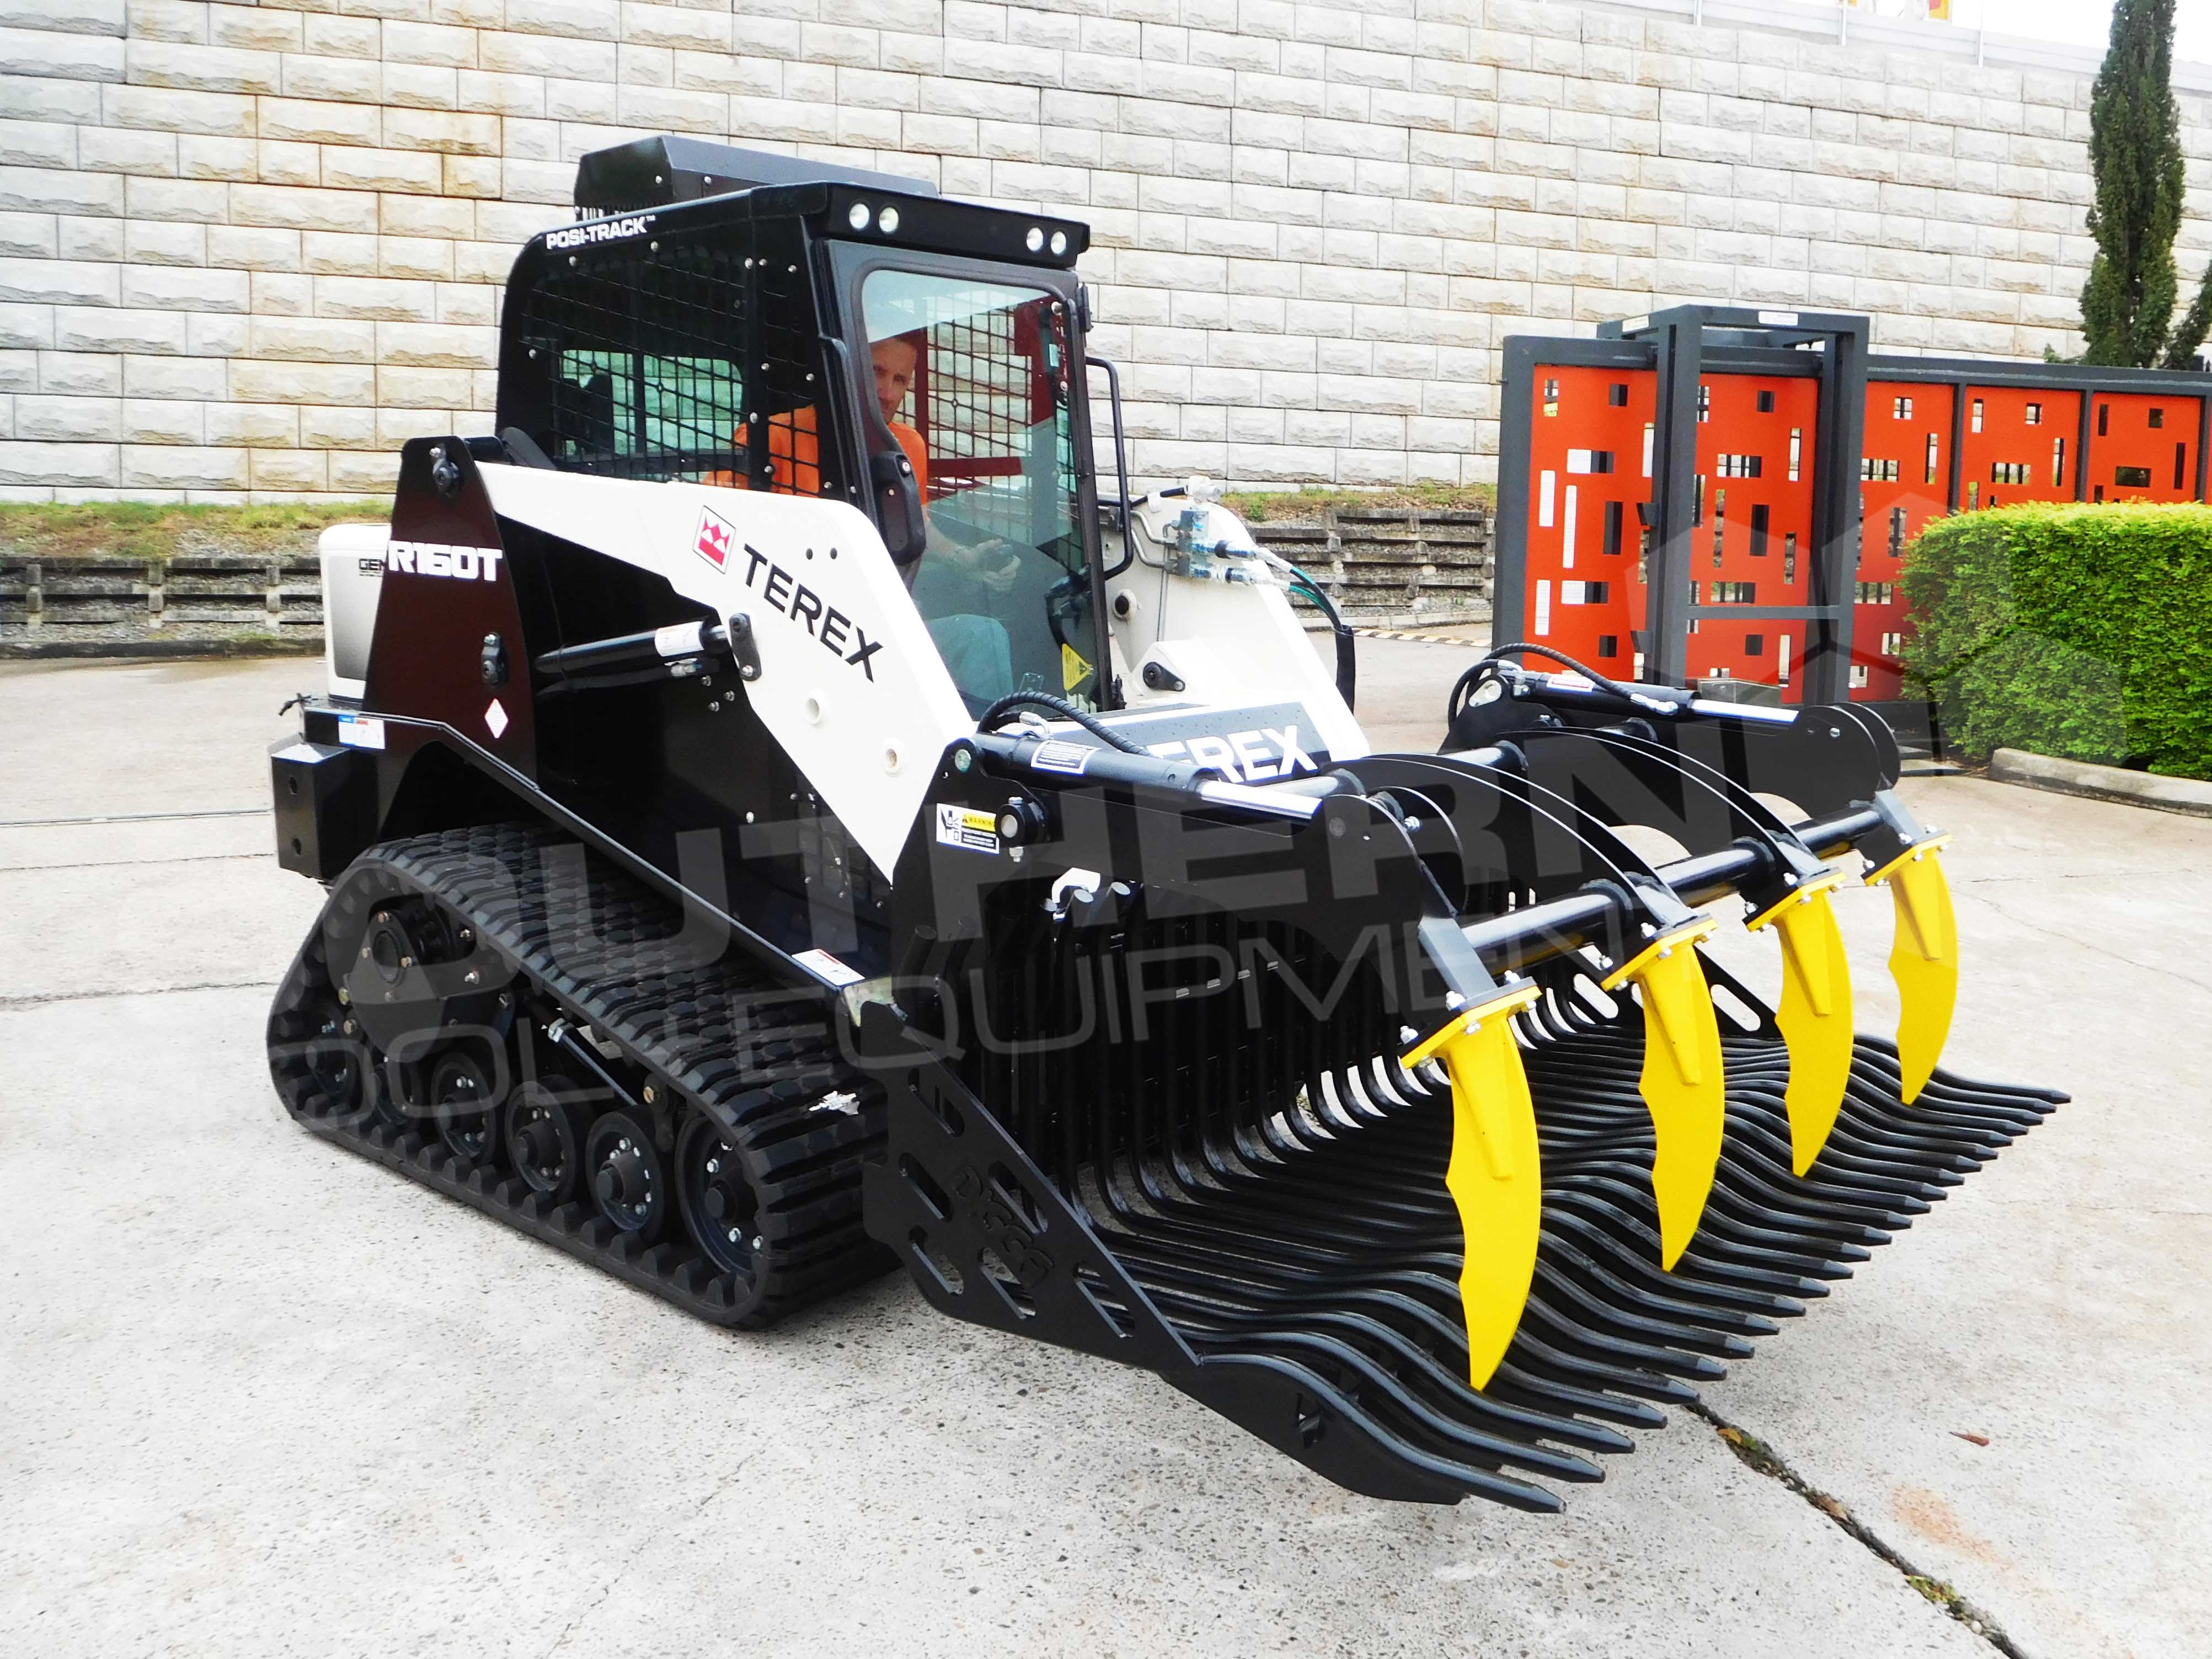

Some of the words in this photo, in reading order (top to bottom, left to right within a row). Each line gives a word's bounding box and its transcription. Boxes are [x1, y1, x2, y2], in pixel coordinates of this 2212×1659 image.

[388, 540, 503, 581] R160T
[744, 543, 883, 683] TEREX
[1146, 725, 1318, 783] REX
